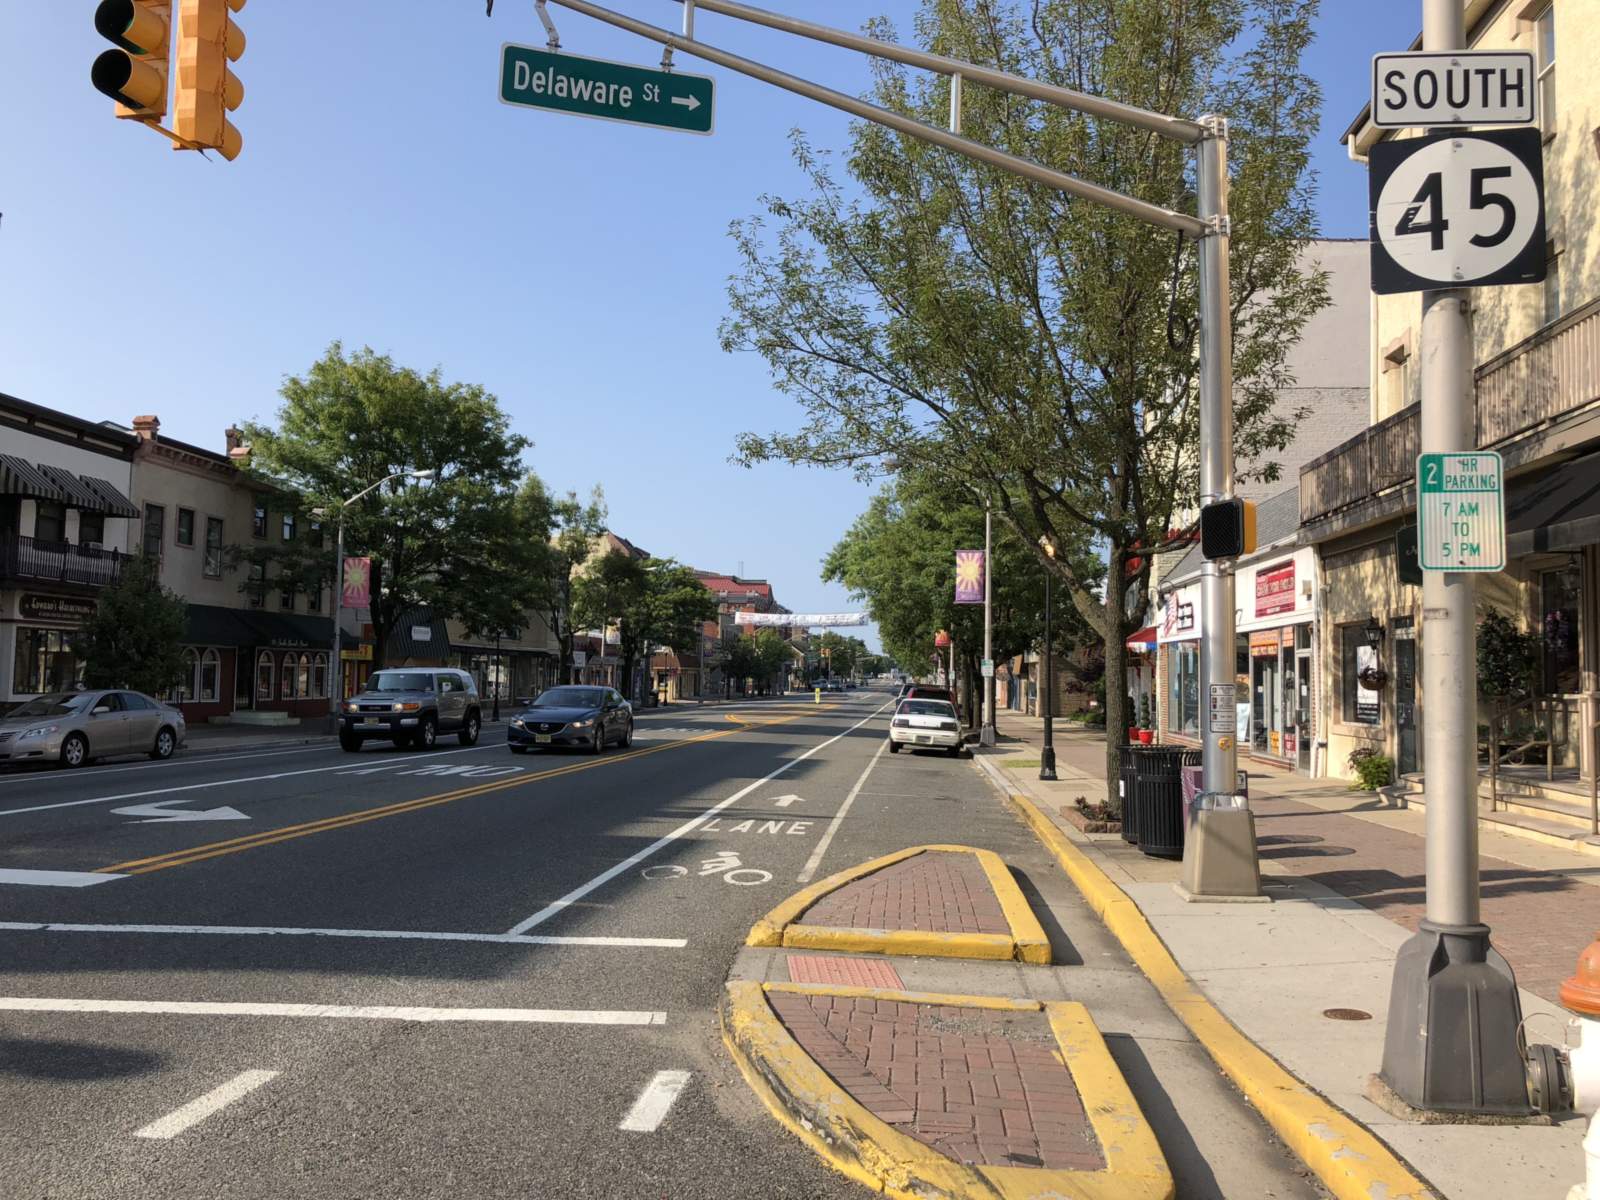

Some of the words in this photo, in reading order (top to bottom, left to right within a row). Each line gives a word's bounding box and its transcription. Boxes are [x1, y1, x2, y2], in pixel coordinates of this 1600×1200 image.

[513, 60, 633, 108] Delaware
[642, 82, 661, 103] St
[1383, 68, 1524, 111] SOUTH
[1394, 166, 1516, 251] 45
[1426, 462, 1438, 485] 2
[1461, 458, 1478, 472] HR
[1445, 474, 1496, 489] PARKING
[1442, 502, 1451, 517] 7
[1457, 502, 1479, 517] AM
[1451, 522, 1470, 537] TO
[1442, 542, 1452, 557] 5
[1459, 542, 1481, 557] PM
[700, 818, 814, 835] LANE
